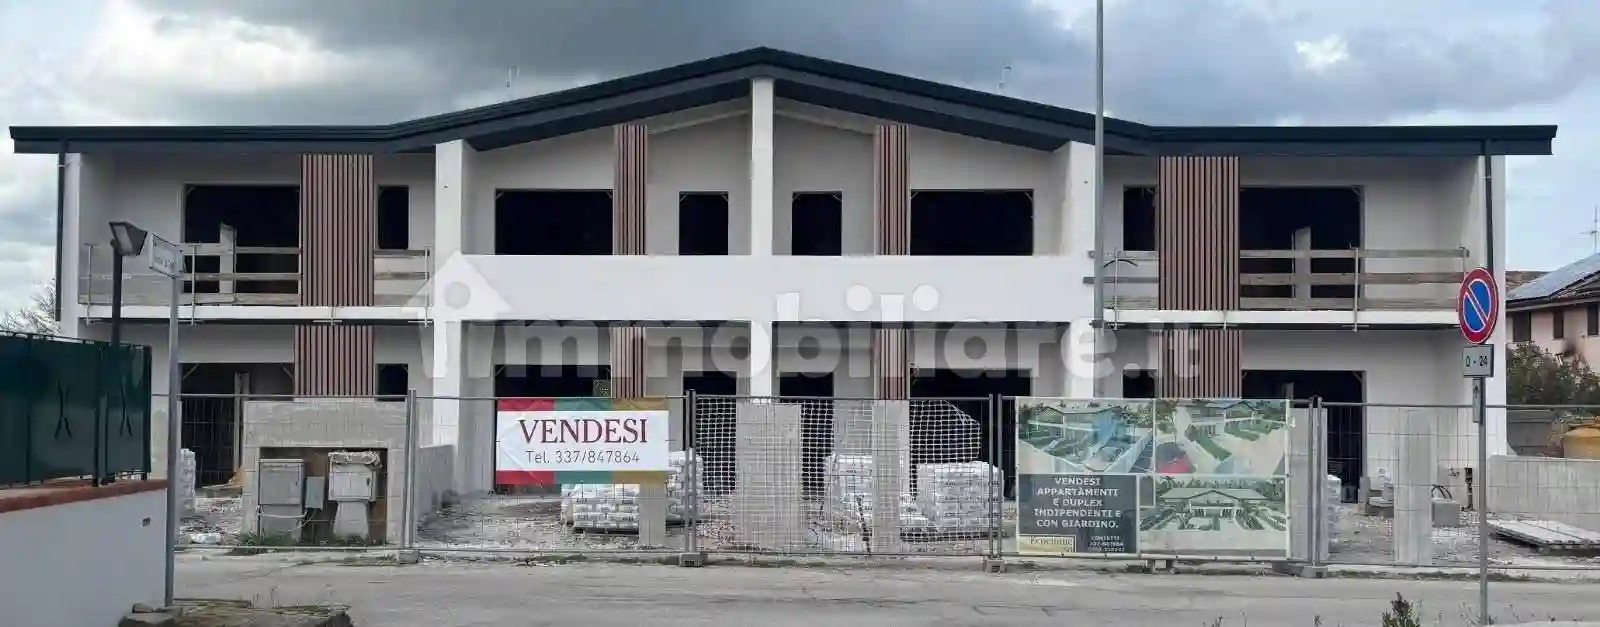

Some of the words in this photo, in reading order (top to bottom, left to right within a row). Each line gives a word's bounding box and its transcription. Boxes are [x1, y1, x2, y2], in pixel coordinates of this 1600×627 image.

[1465, 355, 1471, 368] 0
[1479, 355, 1488, 367] 24
[518, 418, 648, 444] VENDESI
[525, 450, 551, 464] Tel.
[555, 450, 640, 464] 337/847864
[1054, 477, 1101, 486] VENDESI
[1036, 487, 1119, 497] APPARTAMENTI
[1052, 498, 1060, 506] E
[1062, 498, 1104, 507] DUPLEX
[1033, 508, 1113, 518] INDIPENDENTI
[1115, 510, 1121, 518] E
[1036, 519, 1058, 528] CON
[1061, 519, 1119, 529] GIARDINO.
